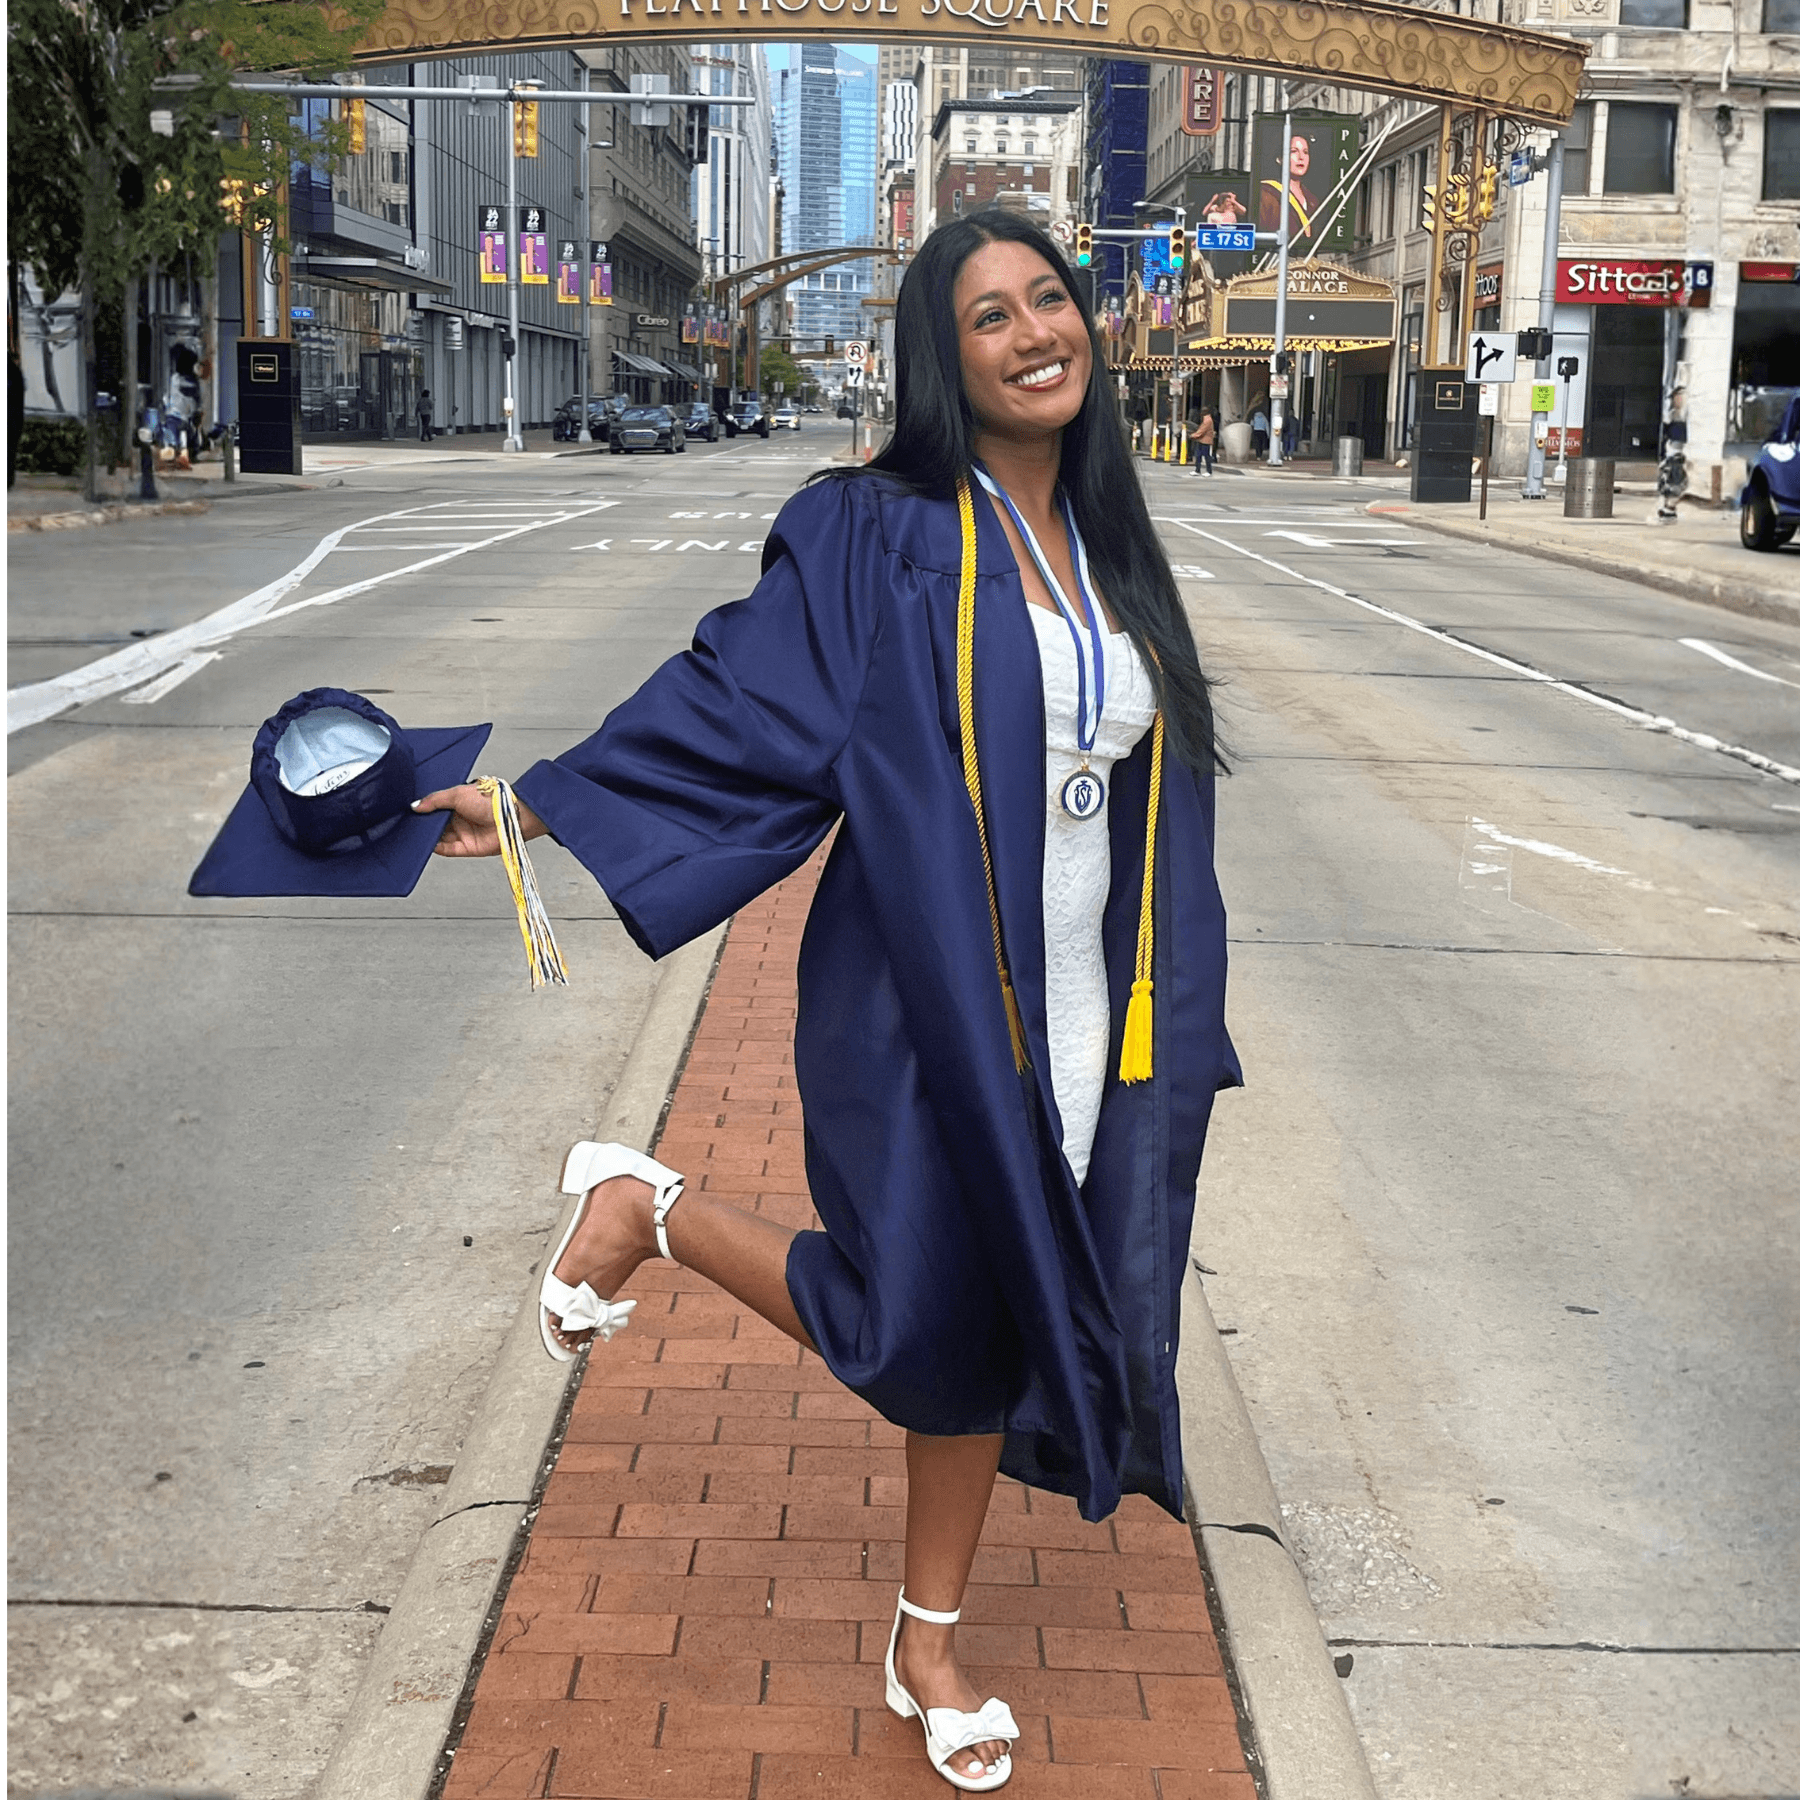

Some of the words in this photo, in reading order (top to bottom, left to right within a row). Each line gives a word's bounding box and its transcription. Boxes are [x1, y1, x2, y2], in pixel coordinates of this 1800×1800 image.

[1217, 233, 1231, 246] 17
[1233, 233, 1249, 246] St
[1285, 280, 1348, 293] ALACE
